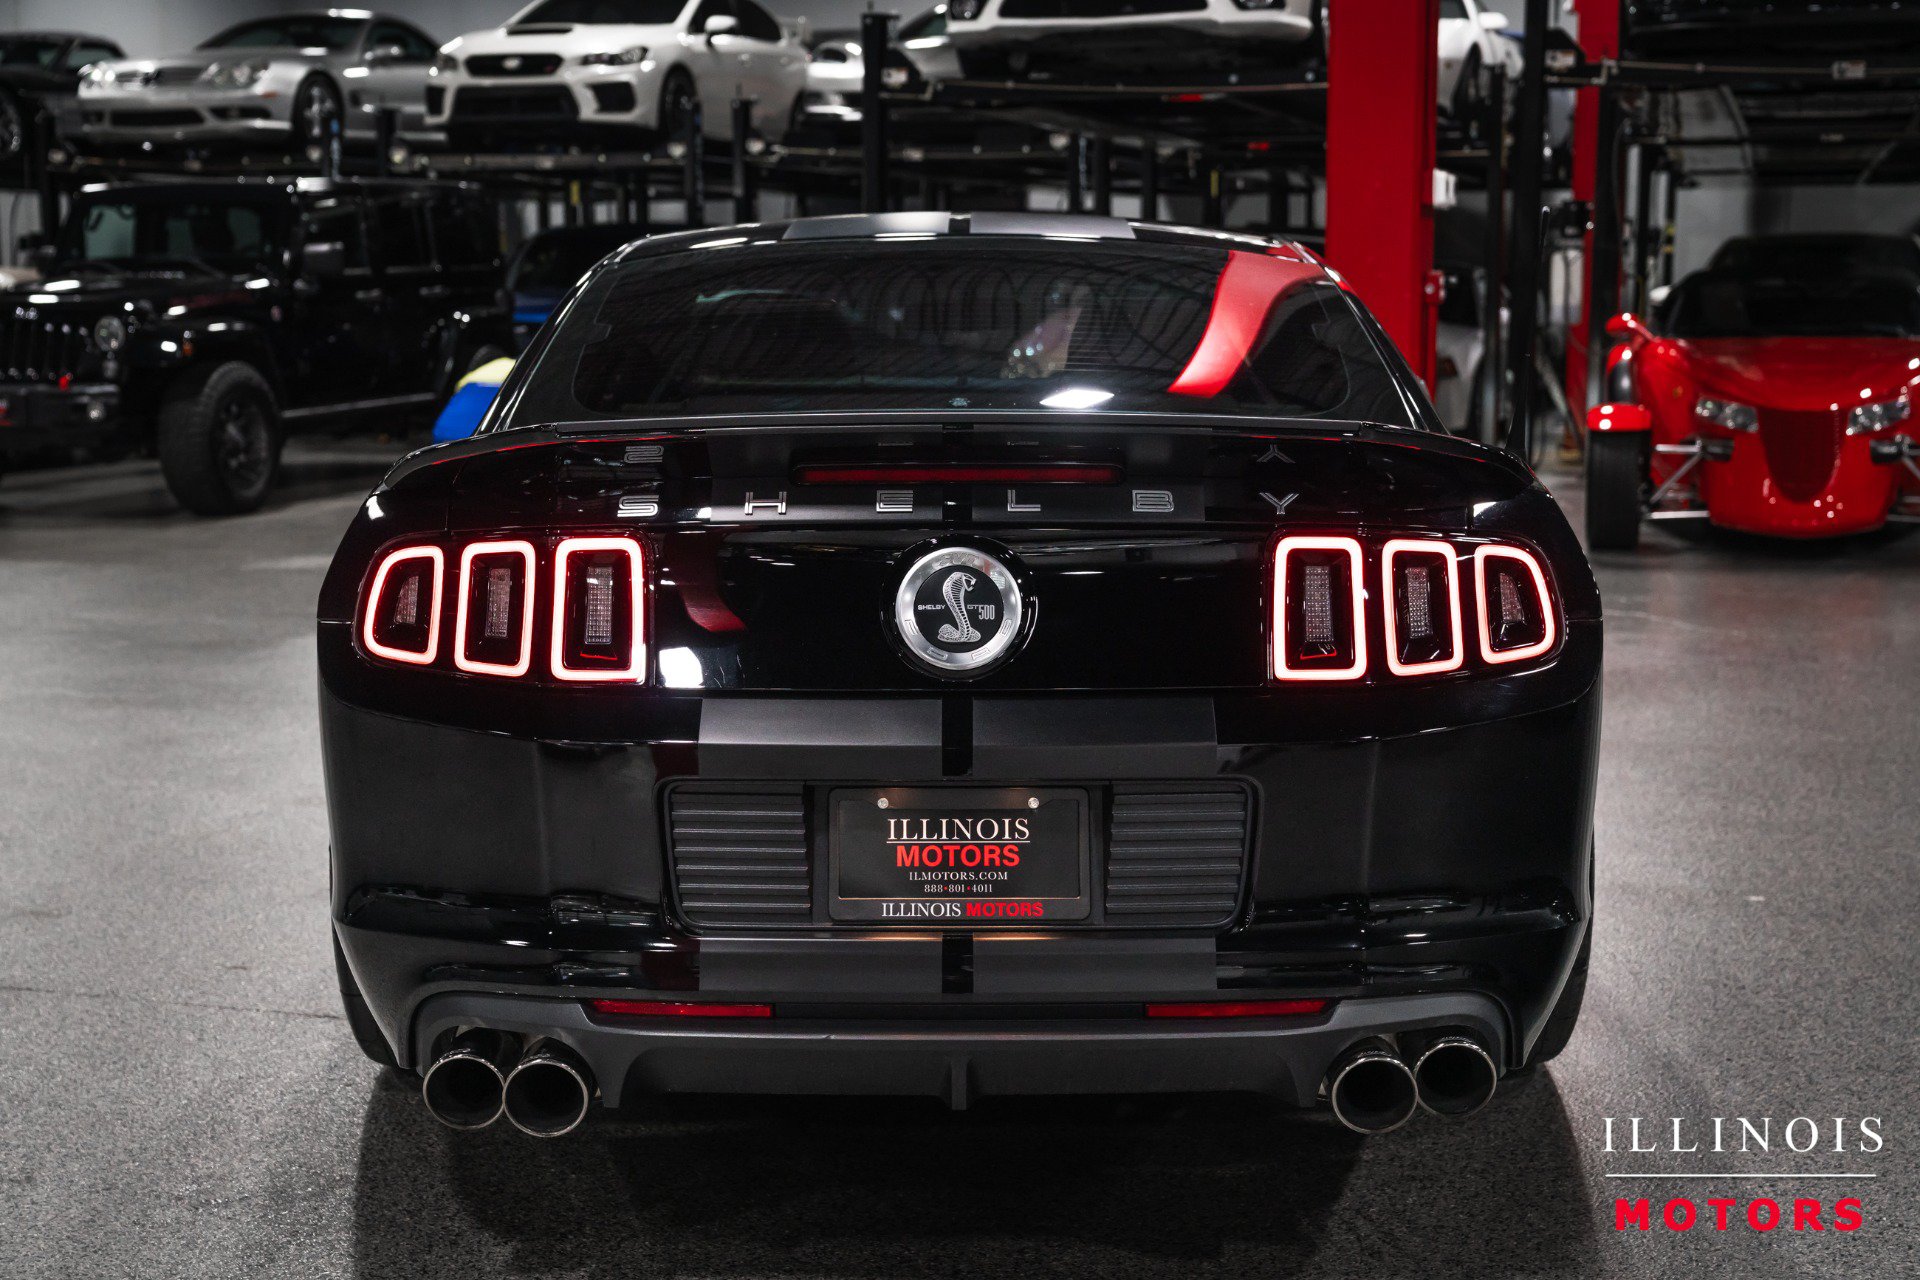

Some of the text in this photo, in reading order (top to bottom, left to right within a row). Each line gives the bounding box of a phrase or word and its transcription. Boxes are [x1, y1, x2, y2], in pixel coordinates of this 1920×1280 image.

[617, 489, 1299, 517] SHELBY
[887, 818, 1030, 840] ILLINOIS
[896, 845, 1020, 867] MOTORS
[909, 871, 1008, 881] ILMOTORS.COM
[881, 902, 1044, 917] ILLINOIS MOTORS
